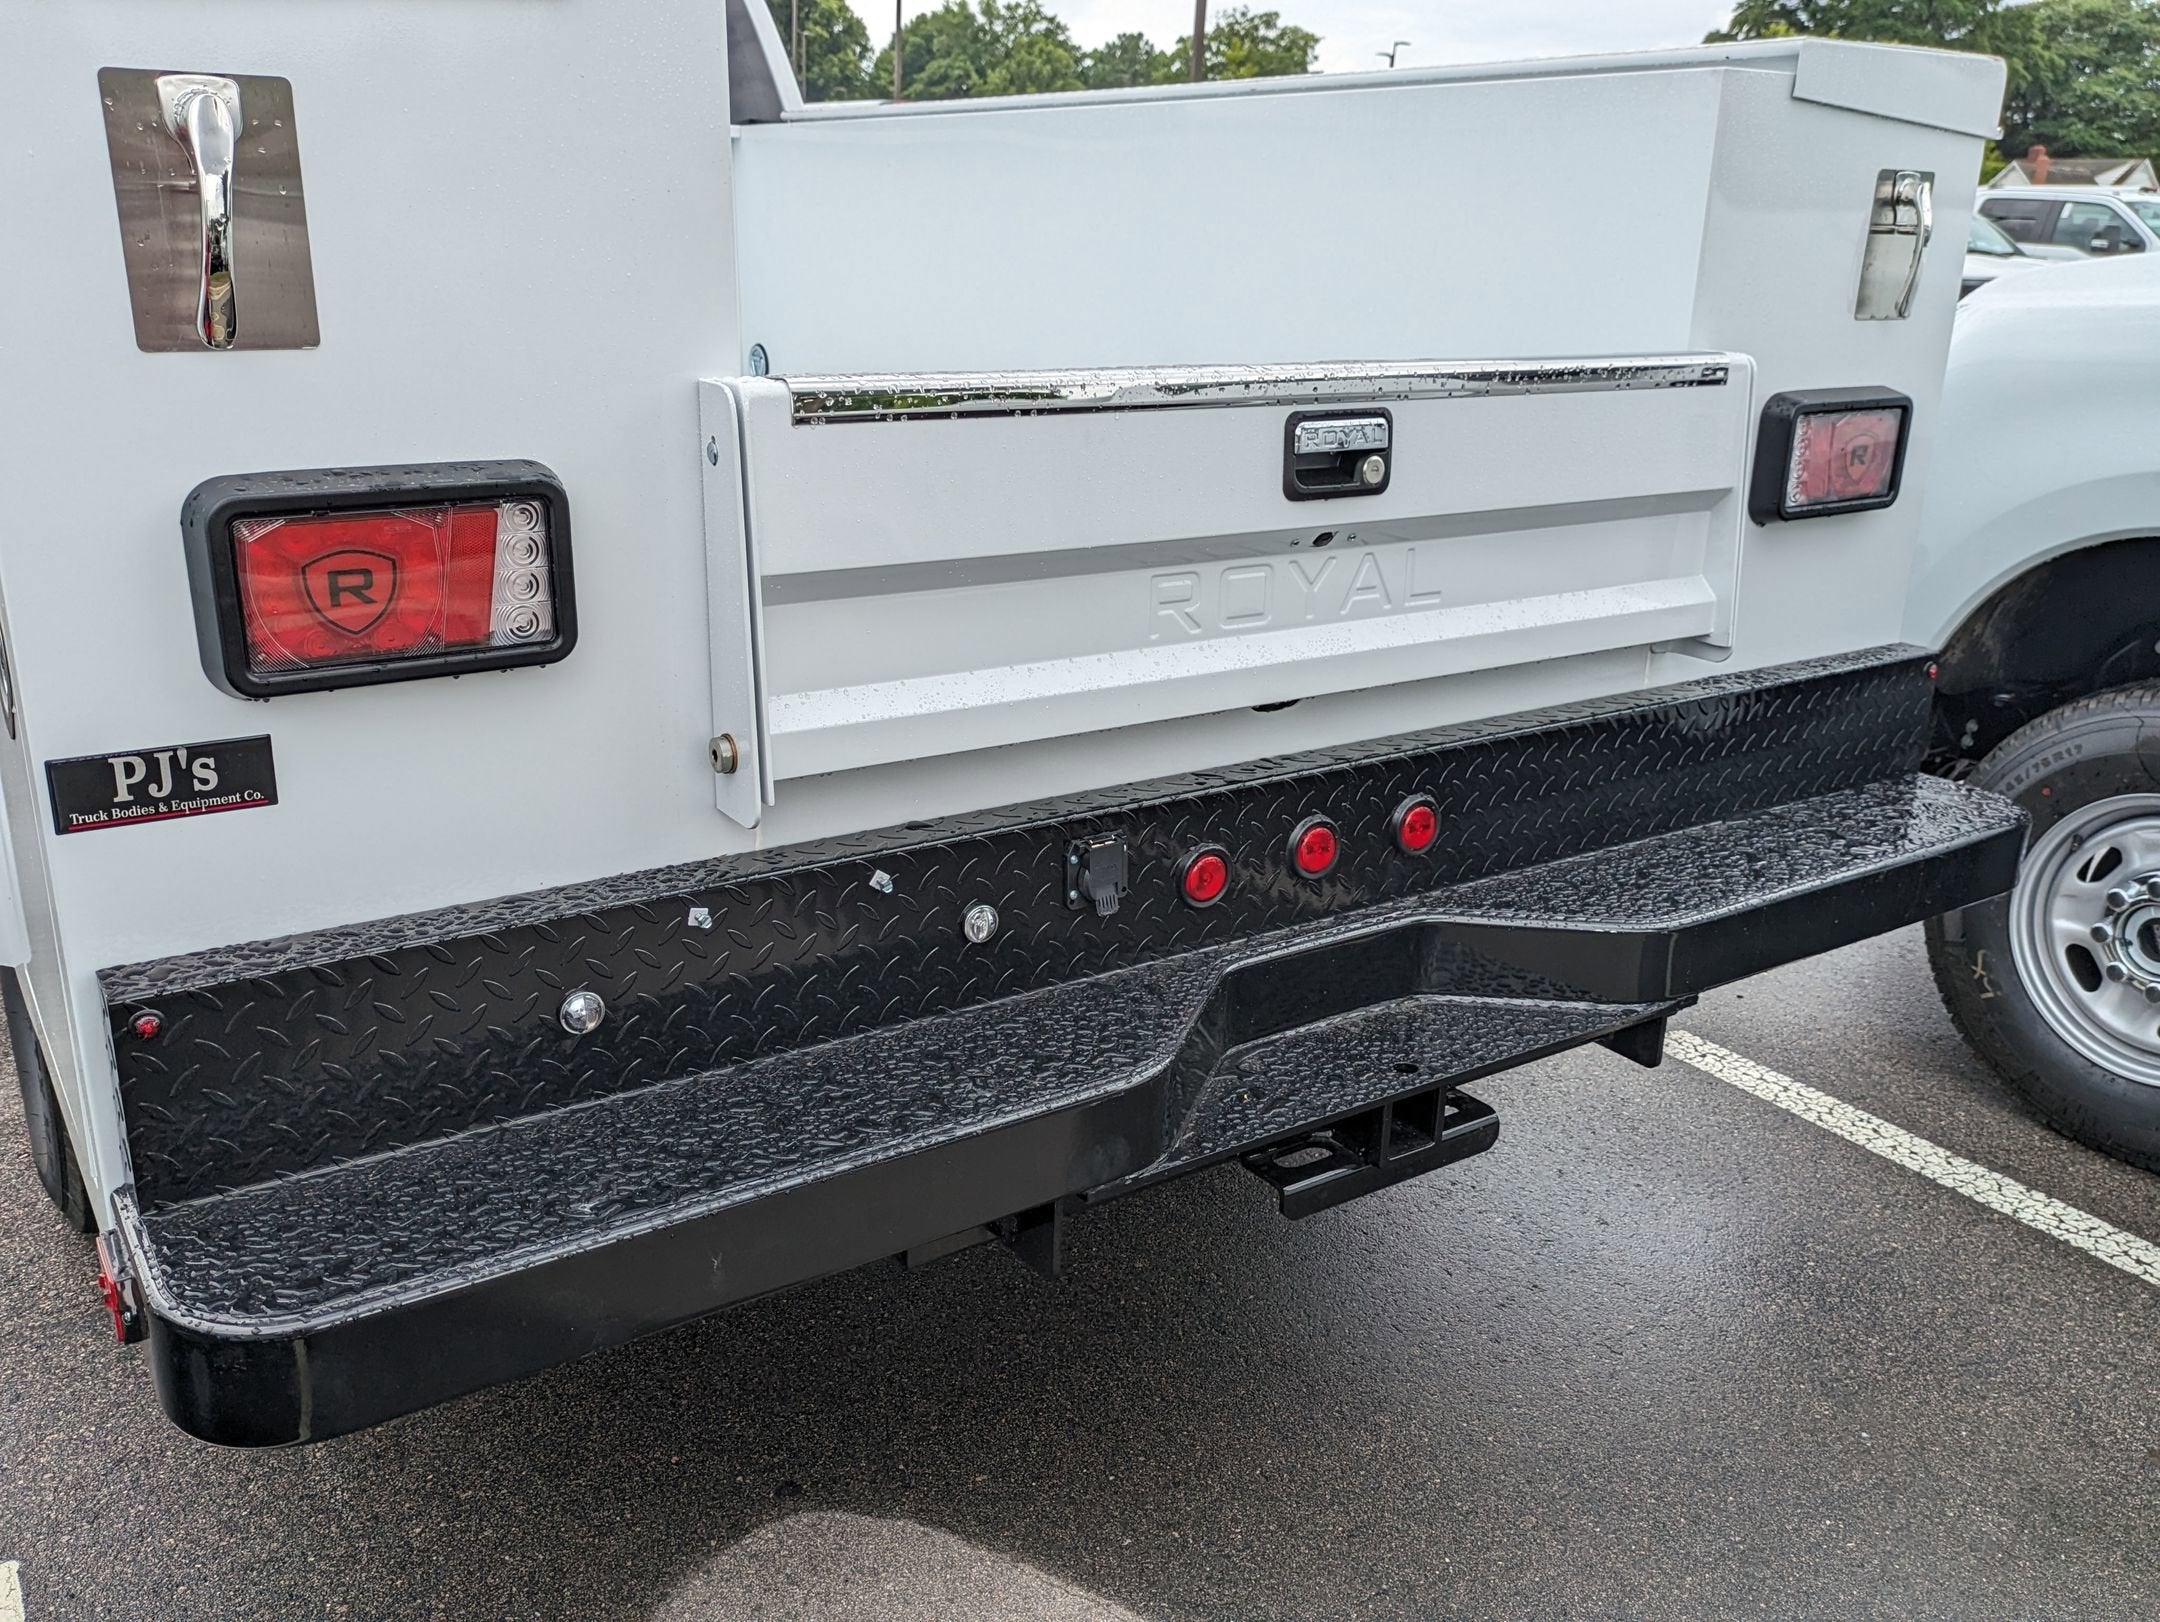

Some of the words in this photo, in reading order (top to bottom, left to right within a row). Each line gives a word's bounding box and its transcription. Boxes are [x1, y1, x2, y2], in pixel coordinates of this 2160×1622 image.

[1304, 426, 1384, 448] ROYAL
[1851, 445, 1868, 466] R
[327, 567, 378, 607] R
[1150, 548, 1443, 639] ROYAL
[108, 746, 218, 802] PJ's
[69, 810, 110, 825] Truck
[111, 804, 155, 819] Bodies
[158, 801, 168, 812] &
[171, 791, 241, 814] Equipment
[244, 789, 265, 801] Co.
